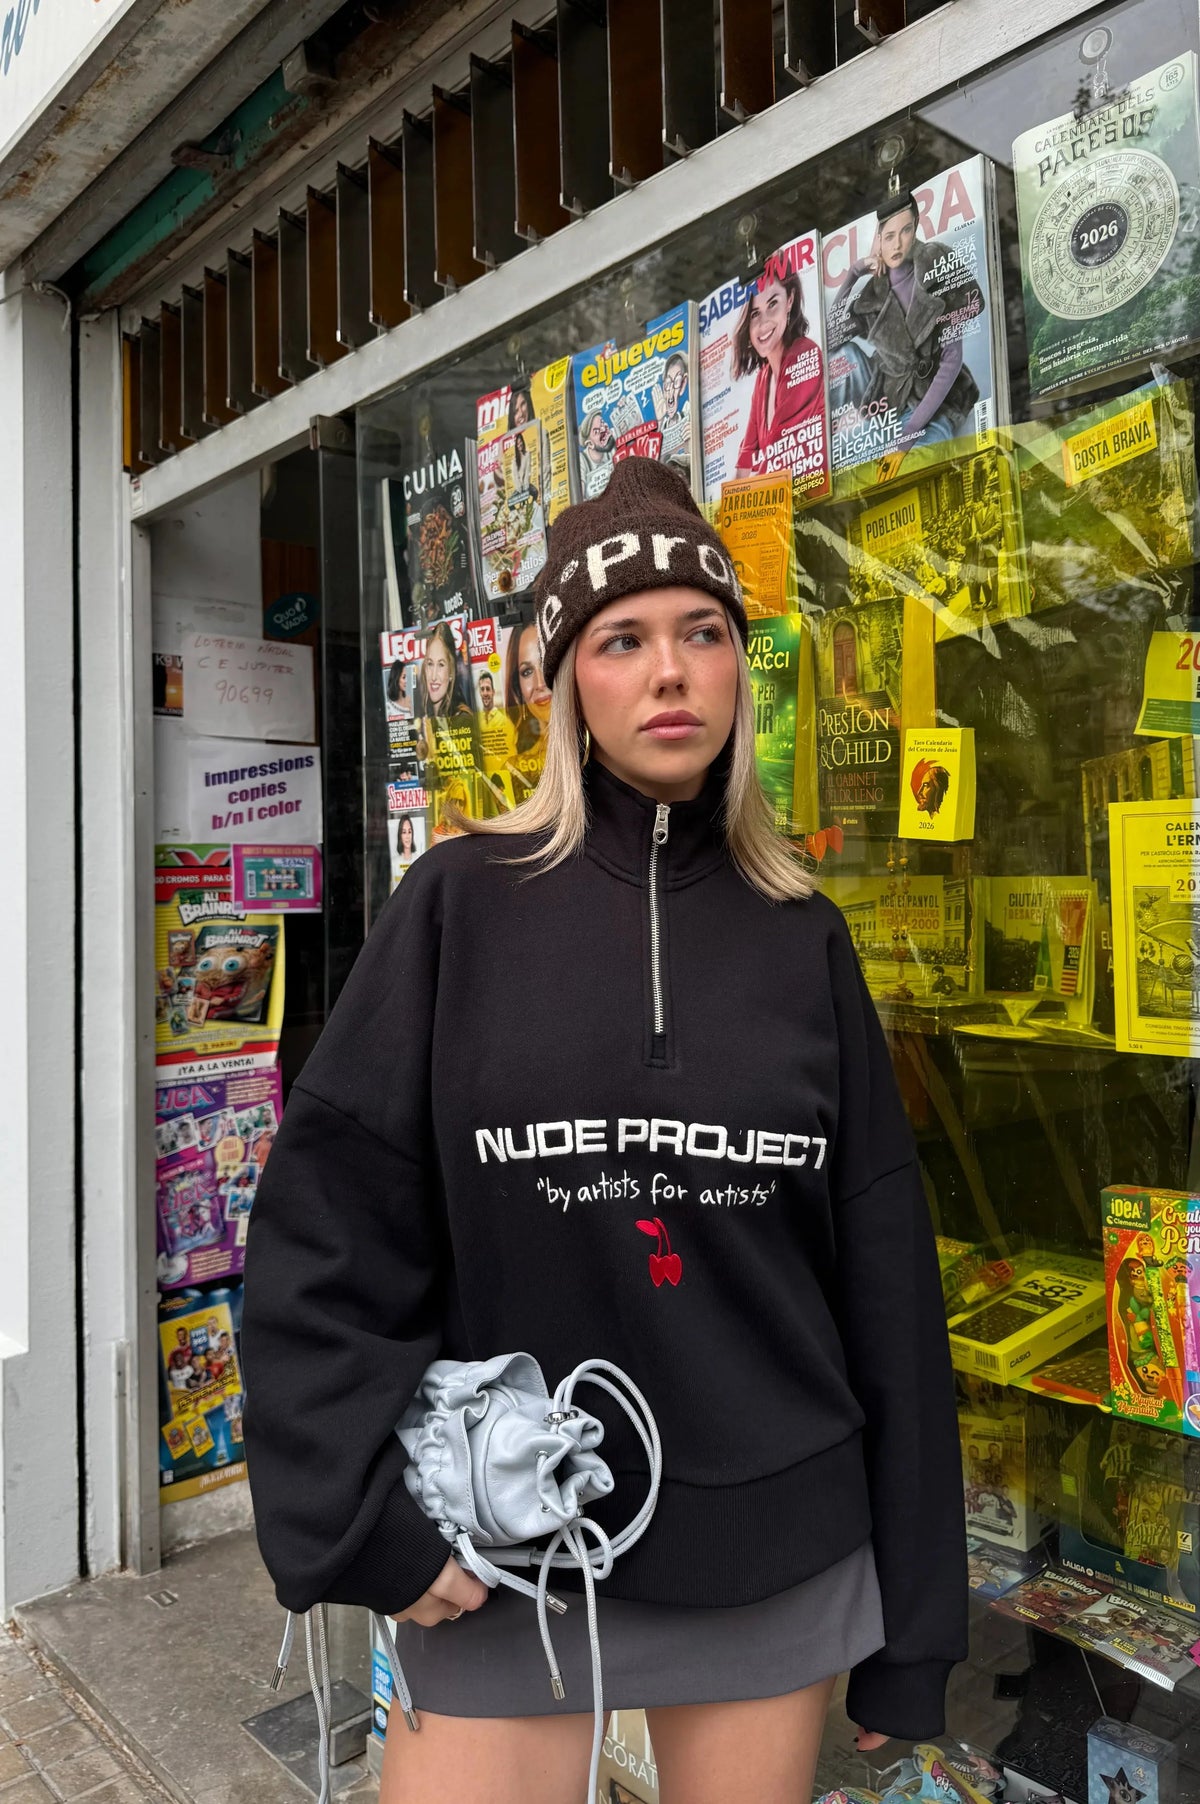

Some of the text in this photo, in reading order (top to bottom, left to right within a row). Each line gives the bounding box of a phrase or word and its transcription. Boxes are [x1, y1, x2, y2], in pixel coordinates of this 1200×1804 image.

[1034, 109, 1112, 153] CALENDARI
[1037, 108, 1156, 187] PAGESOS
[822, 170, 976, 288] CLRA
[1079, 220, 1119, 250] 2026
[952, 233, 976, 250] SIGUE
[933, 243, 977, 269] LA DIETA
[965, 289, 979, 304] 12
[936, 302, 980, 325] PROBLEMAS
[951, 309, 980, 326] BEAUTY
[797, 350, 809, 361] LOS
[1082, 333, 1129, 356] compartida
[785, 356, 819, 376] ALIMENTOS
[790, 368, 804, 379] CON
[787, 370, 820, 389] MAGNESIO
[831, 401, 854, 416] MODA
[832, 407, 898, 448] EN CLAVE
[752, 422, 823, 467] LA DIETA QUE
[832, 420, 903, 465] ELEGANTE
[1073, 439, 1111, 471] COSTA
[1112, 420, 1151, 453] BRAVA
[766, 436, 823, 474] ACTIVA TU
[403, 449, 463, 501] CUINA
[808, 477, 825, 490] PESO
[724, 488, 785, 512] ZARAGOZANO
[739, 507, 777, 521] FIRMAMENTO
[865, 503, 916, 542] POBLENOU
[512, 550, 521, 577] 2
[586, 532, 735, 597] Pro
[758, 683, 775, 701] PER
[819, 703, 891, 737] PRESTON
[831, 736, 892, 766] CHILD
[836, 771, 880, 787] GABINET
[228, 781, 287, 805] copies
[212, 811, 244, 830] b/n
[257, 799, 302, 820] color
[918, 821, 935, 830] 2026
[166, 874, 224, 883] CROMOS PARA
[1008, 893, 1043, 907] CIUTAT
[205, 933, 269, 949] BRAINROT
[207, 1062, 220, 1070] LA
[221, 1057, 254, 1068] VENTA!
[475, 1118, 827, 1170] NUDE PROJECT
[577, 1169, 641, 1203] artists
[650, 1173, 689, 1205] for
[1045, 1275, 1087, 1291] CASIO
[1009, 1351, 1031, 1369] CASIO
[1062, 1558, 1086, 1574] LALIGA
[1044, 1571, 1102, 1597] BRAINROT
